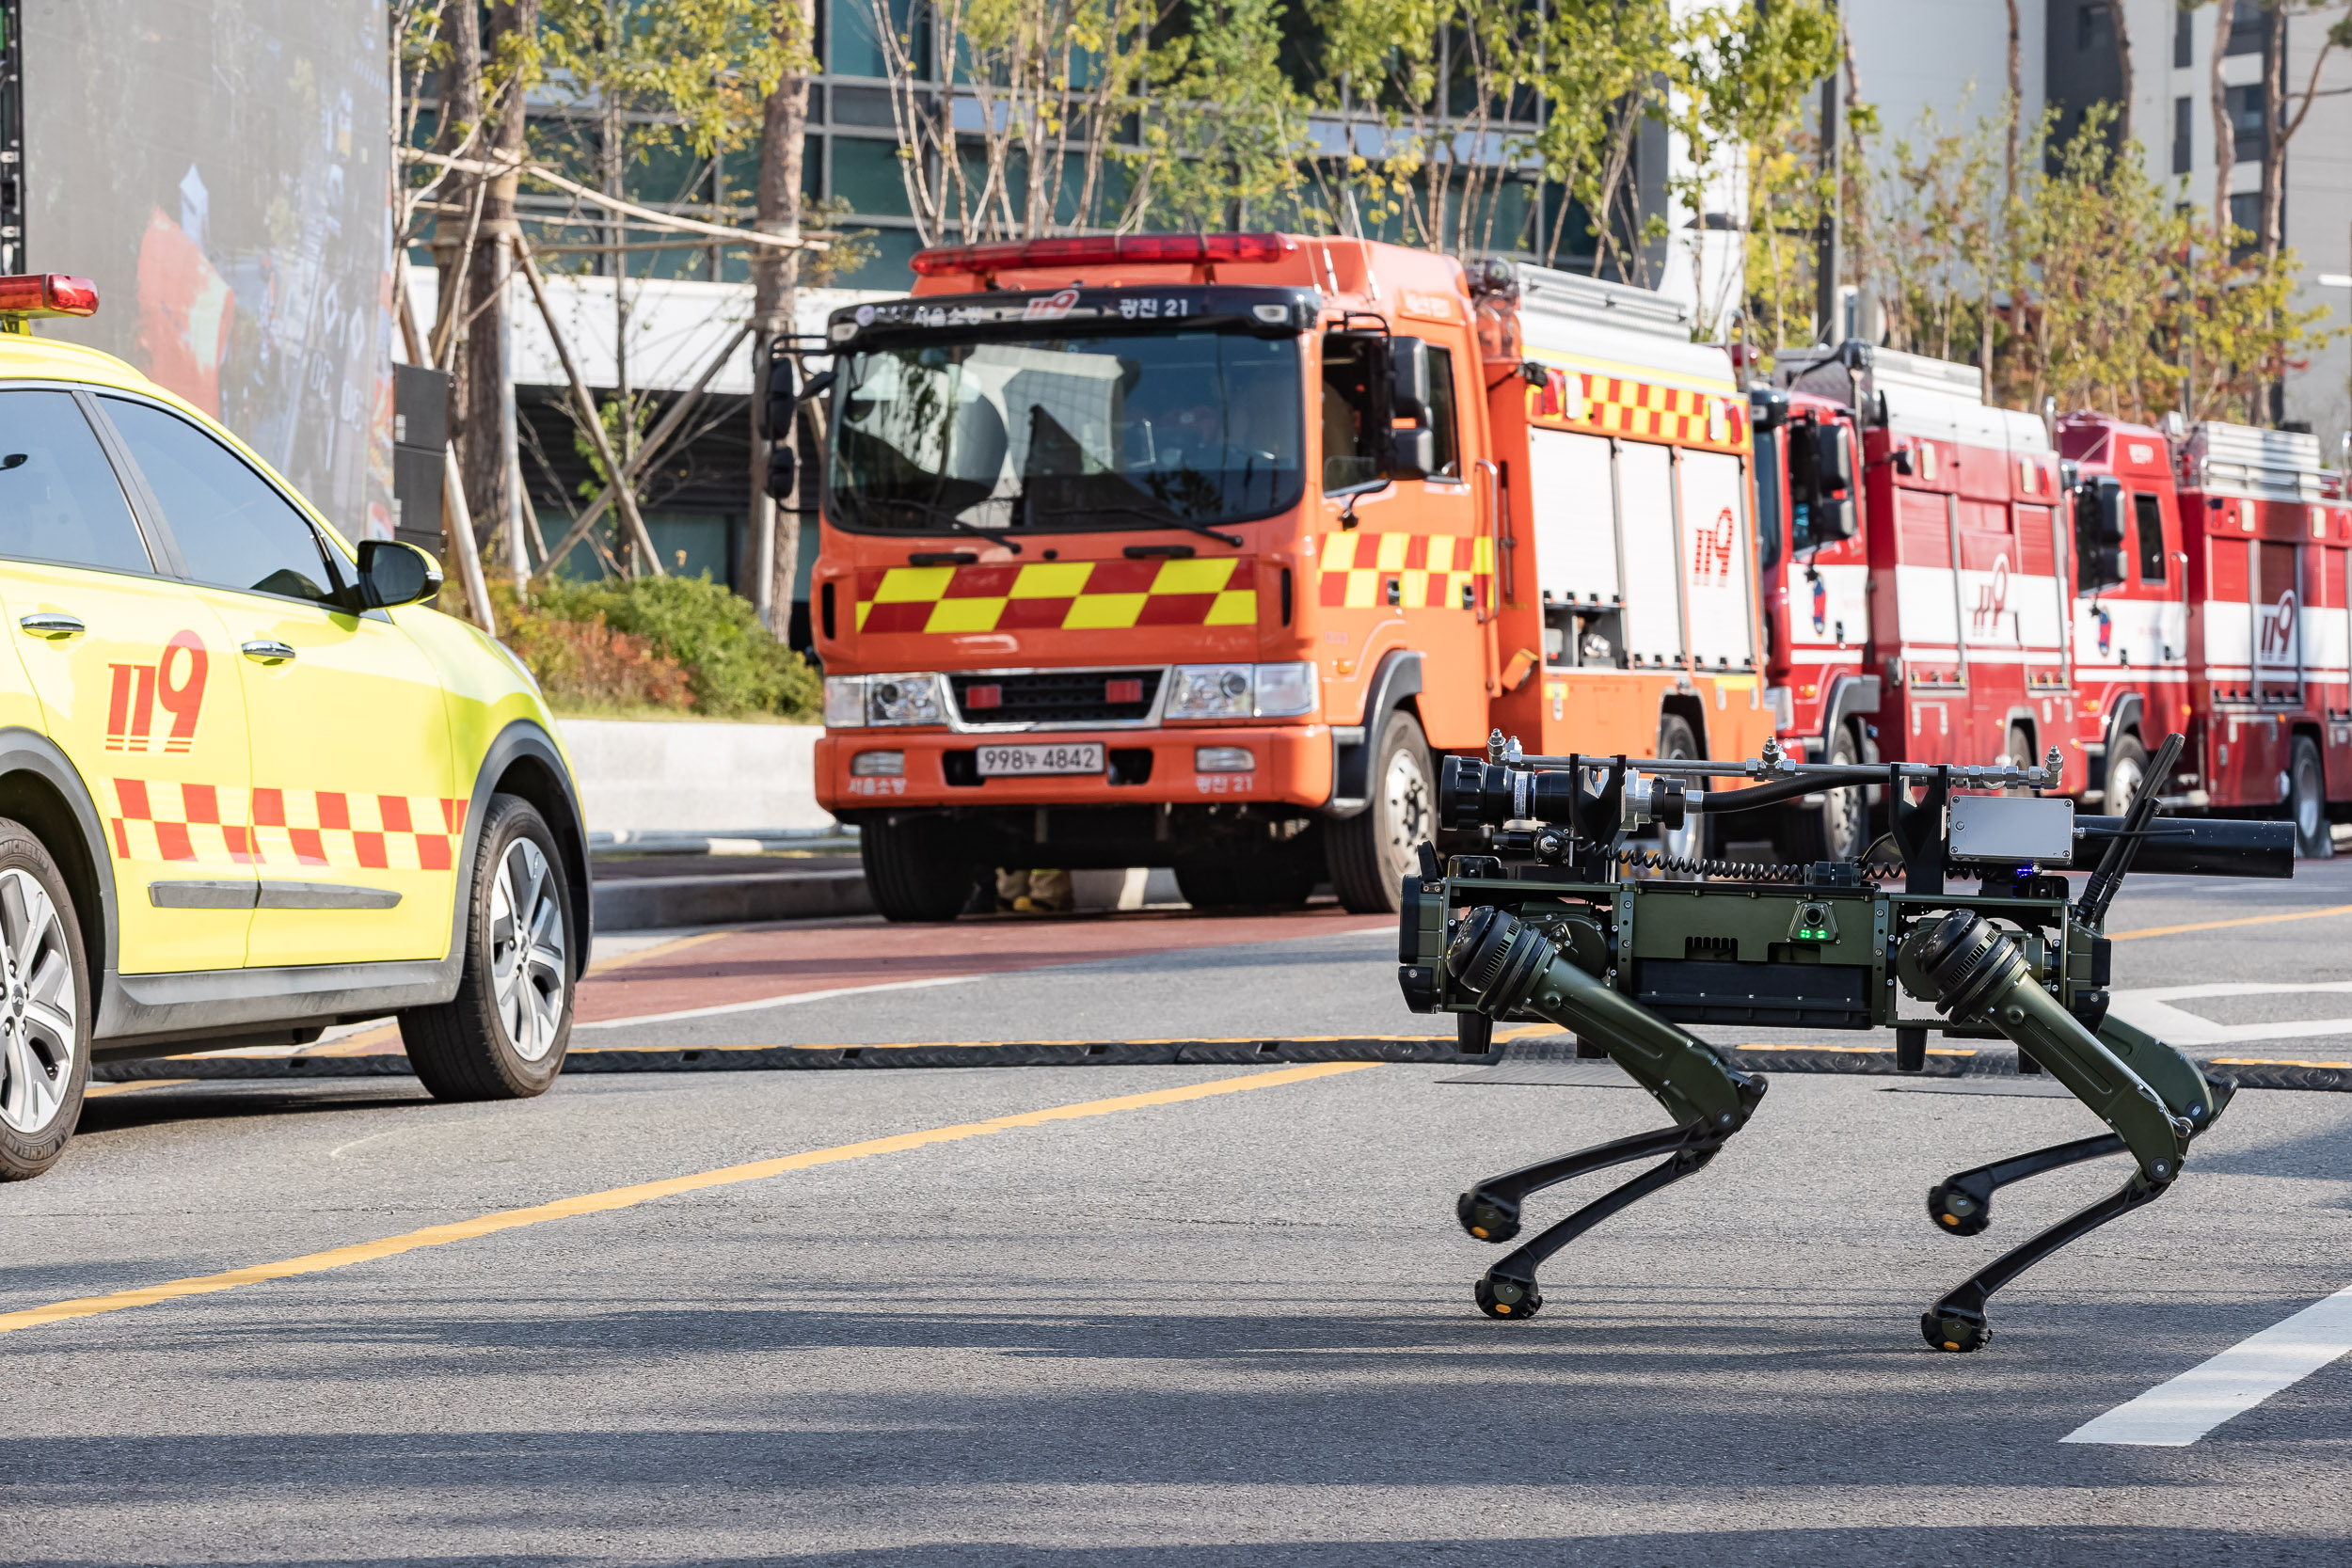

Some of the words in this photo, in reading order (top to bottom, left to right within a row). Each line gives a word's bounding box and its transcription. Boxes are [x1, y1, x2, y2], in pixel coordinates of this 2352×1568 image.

[912, 305, 983, 327] 서울소방
[1024, 290, 1079, 320] 119
[1119, 297, 1158, 319] 광진
[1164, 298, 1189, 317] 21
[1693, 506, 1733, 587] 119
[1973, 555, 2009, 637] 119
[2261, 592, 2294, 661] 119
[104, 628, 210, 753] 119
[1042, 747, 1095, 769] 4842
[1196, 775, 1228, 794] 광진
[1233, 775, 1253, 792] 21
